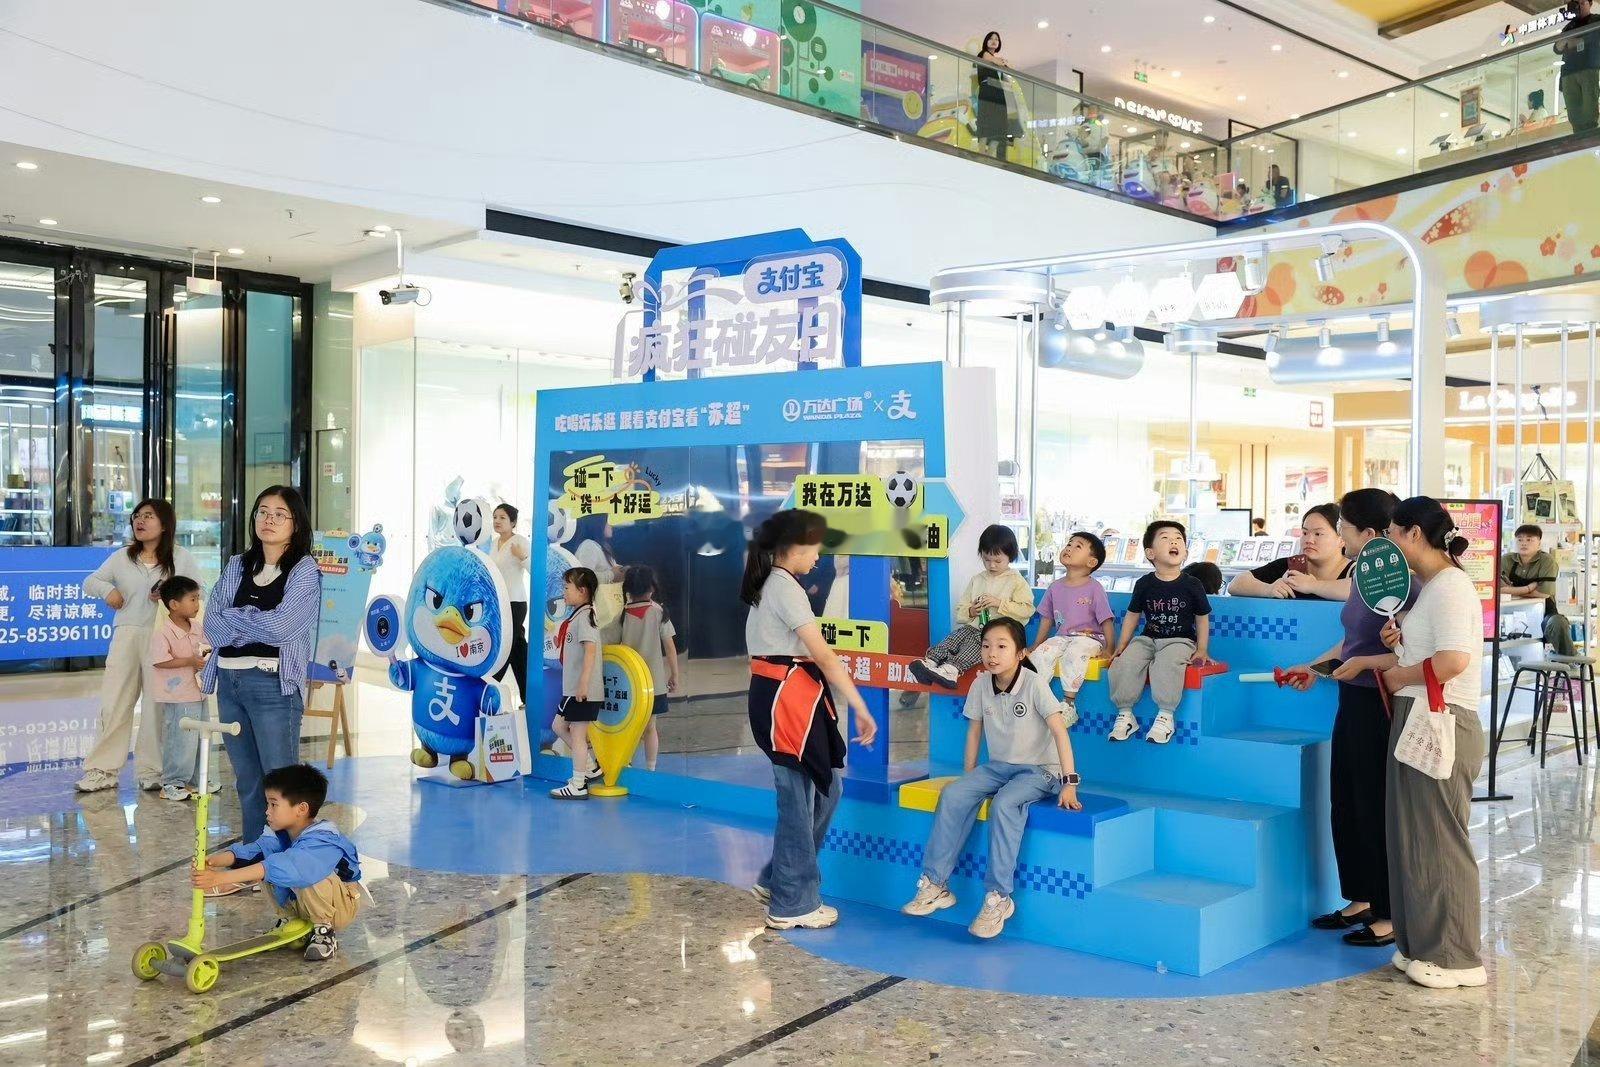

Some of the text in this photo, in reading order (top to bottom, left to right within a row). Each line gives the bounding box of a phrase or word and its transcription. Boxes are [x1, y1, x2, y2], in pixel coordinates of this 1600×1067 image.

[757, 261, 824, 295] 支付宝
[627, 303, 838, 378] 疯狂碰友日
[803, 413, 833, 421] WANDA
[574, 466, 614, 488] 碰一下
[645, 466, 662, 487] Lucky
[802, 481, 872, 508] 我在万达
[821, 623, 871, 648] 碰一下
